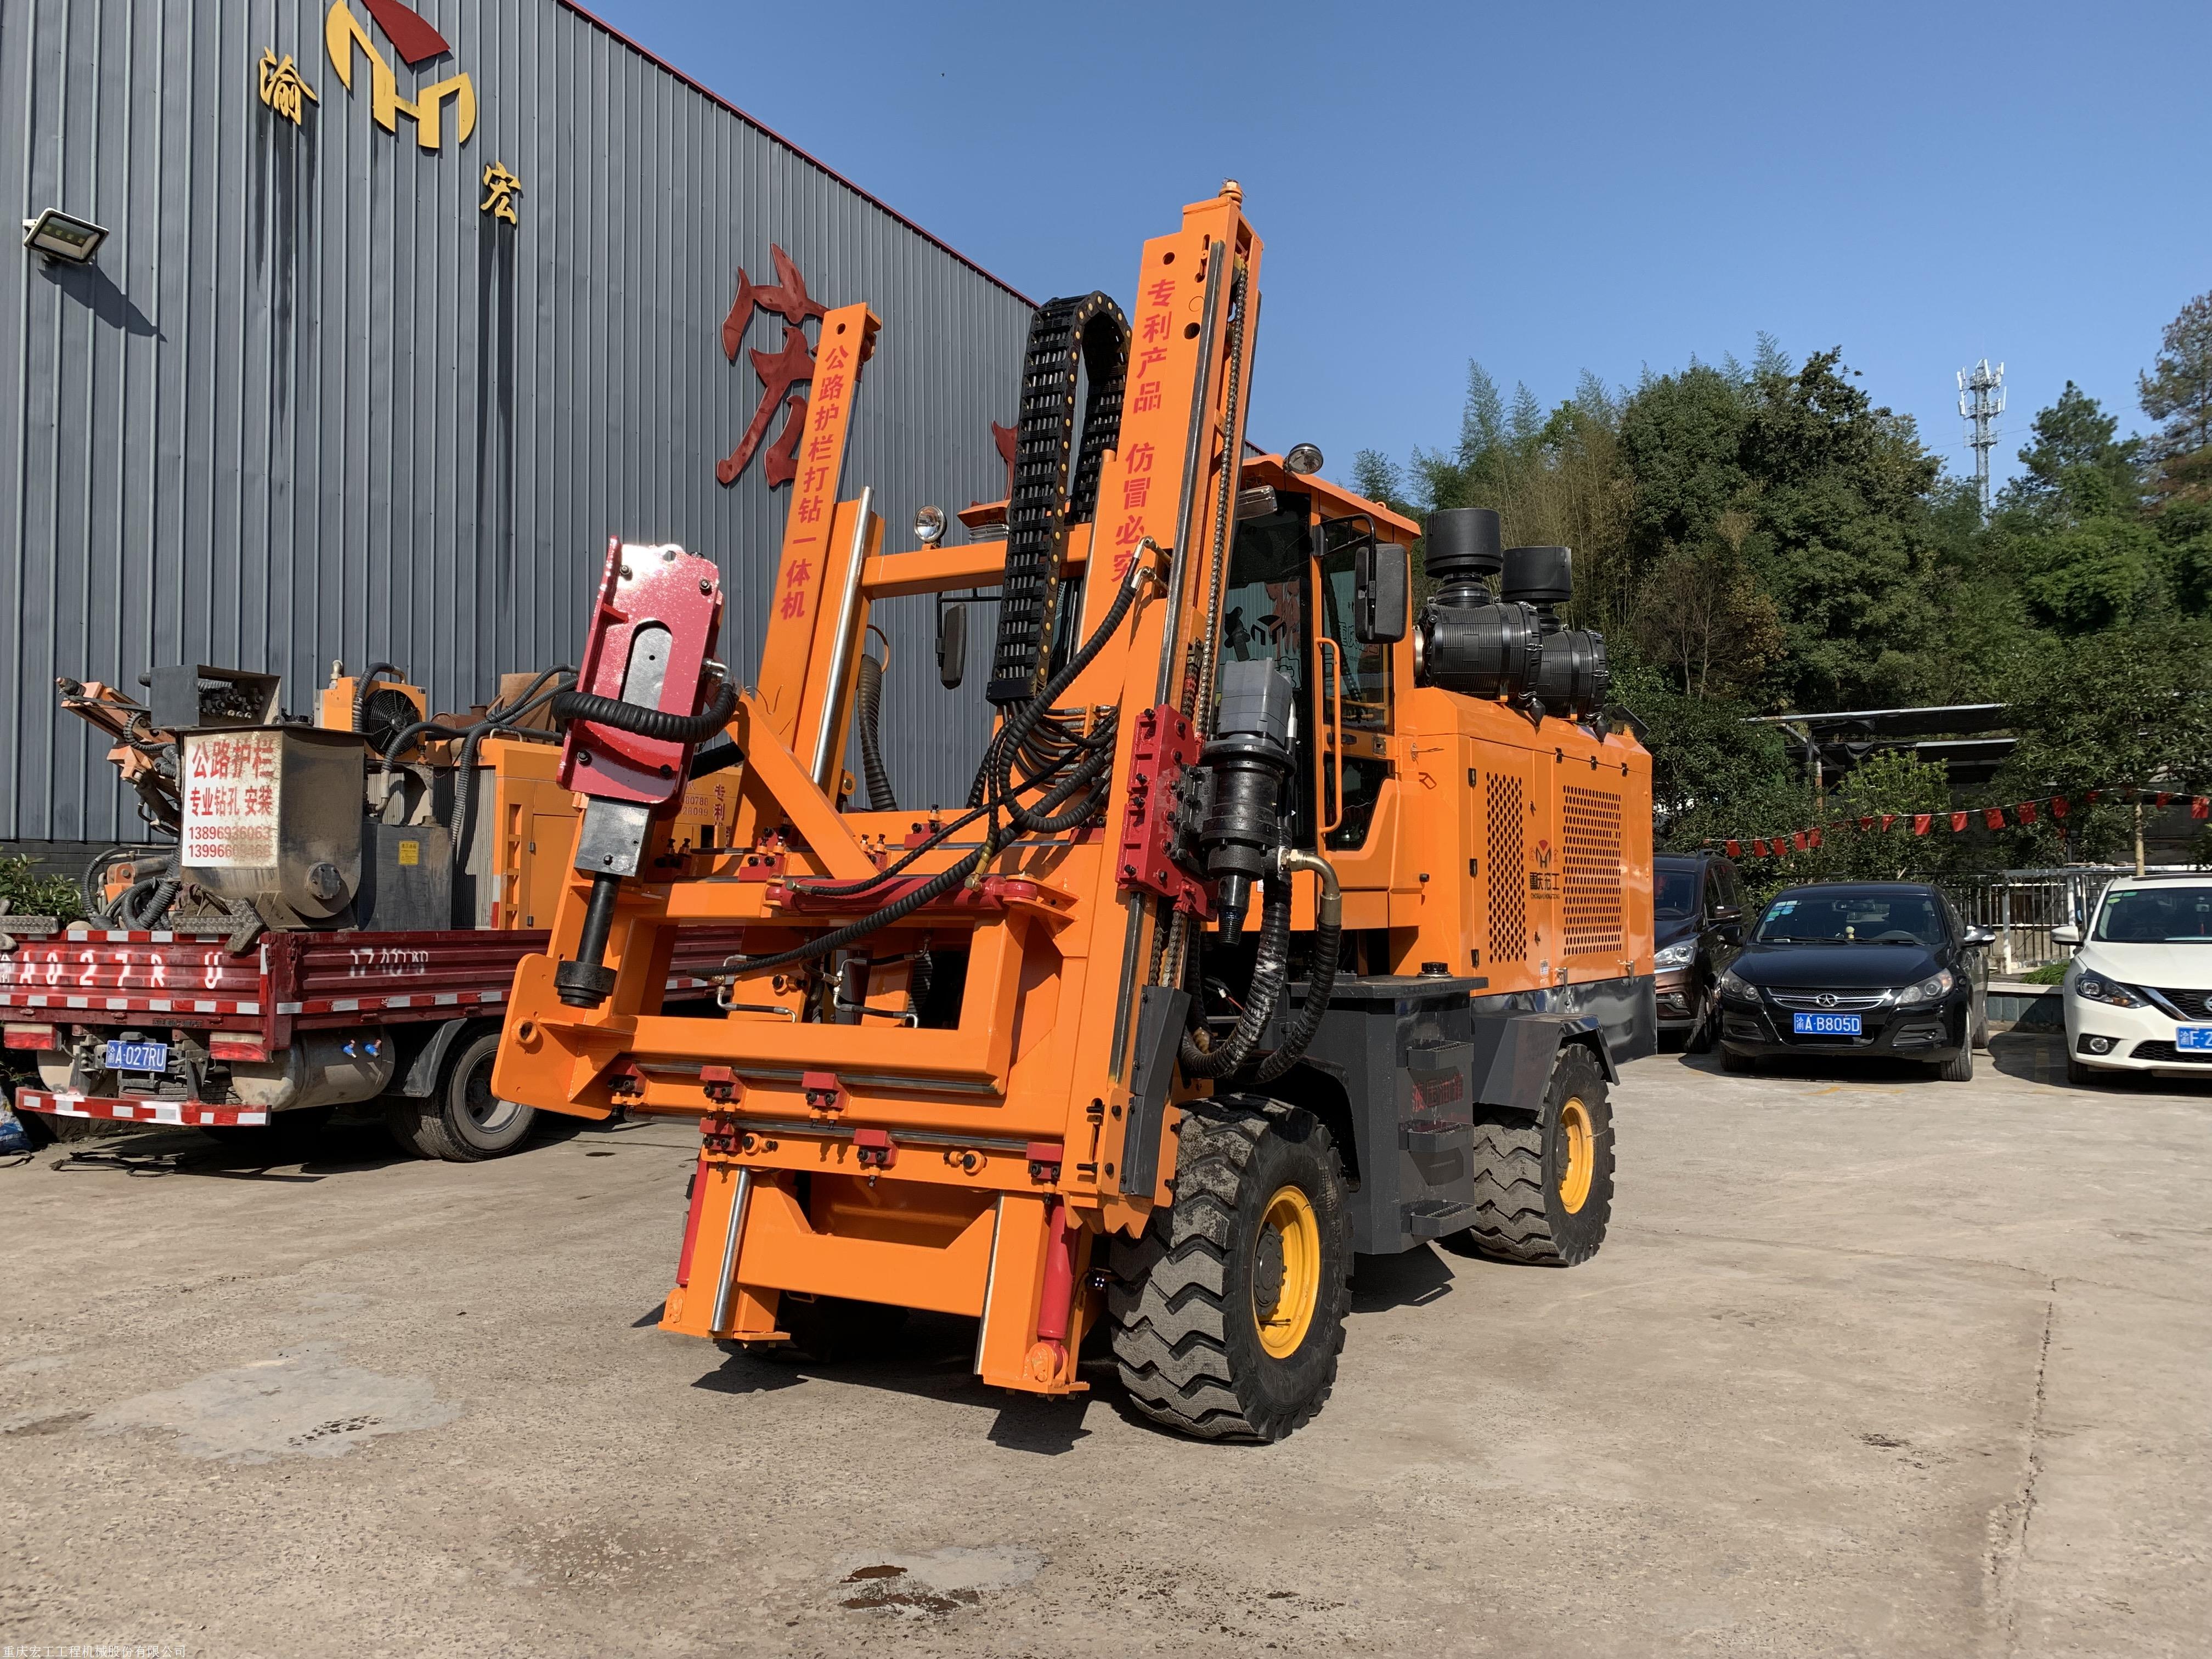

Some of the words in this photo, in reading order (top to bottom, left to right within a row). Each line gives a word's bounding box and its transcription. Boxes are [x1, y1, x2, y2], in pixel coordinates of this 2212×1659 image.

[259, 47, 318, 126] 渝
[480, 161, 521, 224] 宏
[1132, 279, 1176, 414] 专利产品
[780, 344, 849, 621] 公路护栏打钻一体机
[192, 738, 274, 780] 公路护栏
[190, 786, 240, 817] 专业钻孔
[244, 785, 273, 817] 安装
[1530, 871, 1560, 890] 重庆宏工
